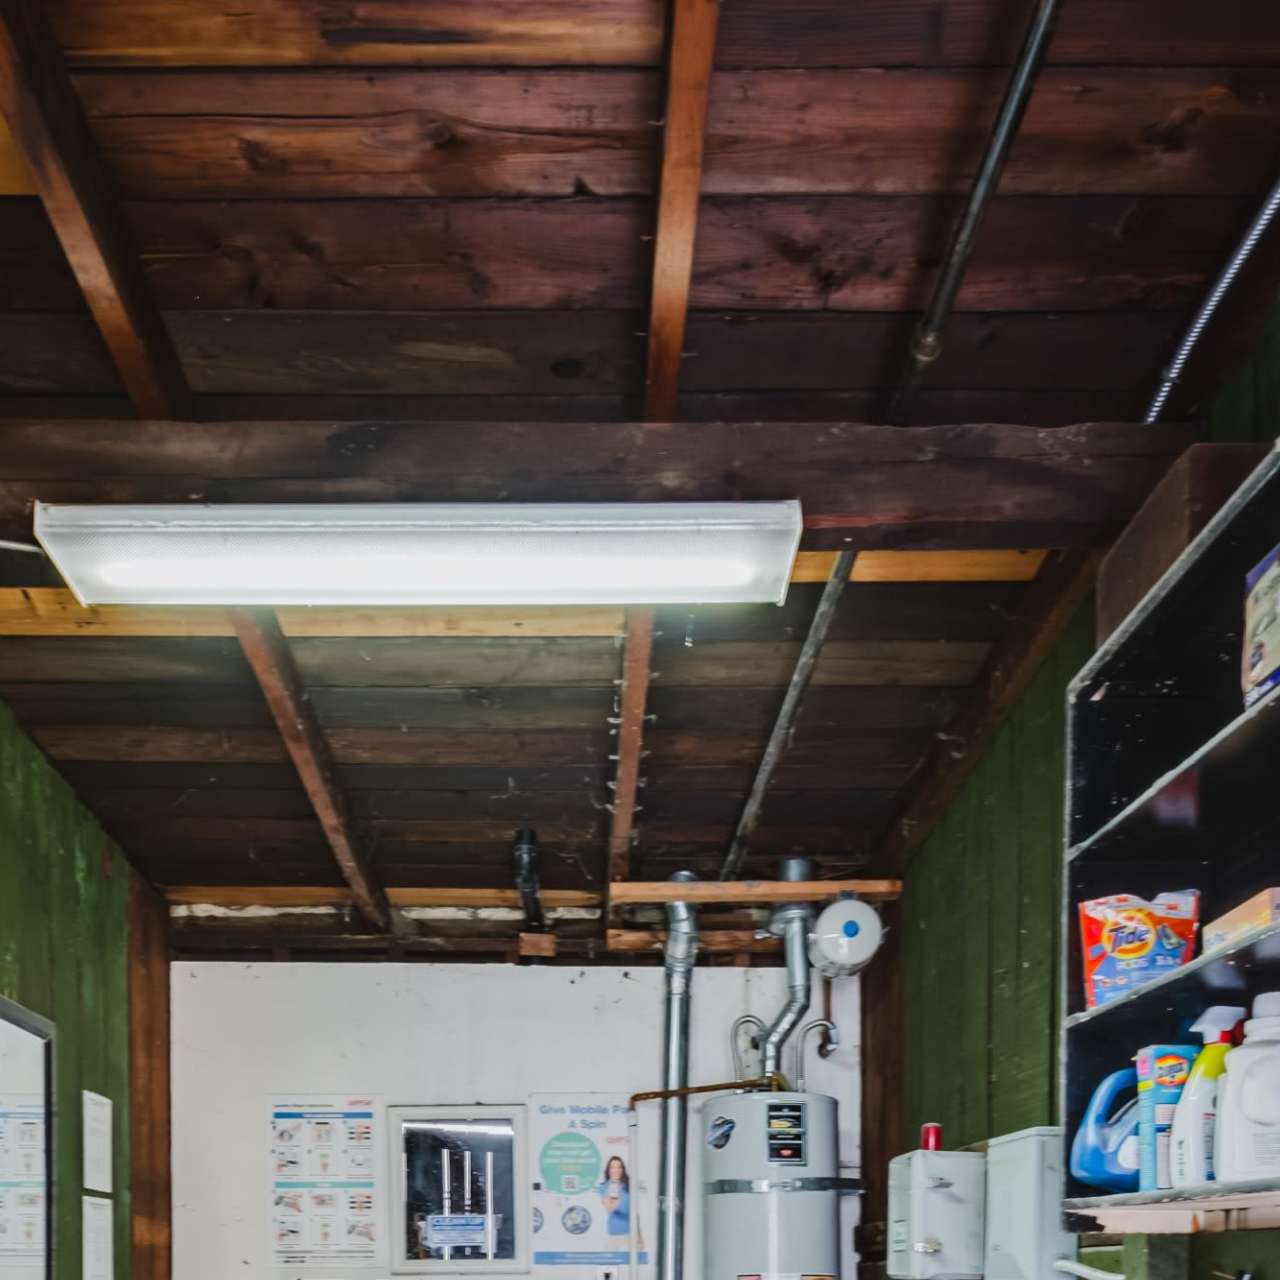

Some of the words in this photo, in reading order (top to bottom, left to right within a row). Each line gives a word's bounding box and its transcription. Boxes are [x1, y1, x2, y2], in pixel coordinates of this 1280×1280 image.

[1107, 924, 1152, 952] Tide
[539, 1104, 566, 1115] Give
[570, 1104, 610, 1115] Mobile
[613, 1104, 630, 1115] Pa
[581, 1119, 607, 1130] Spin
